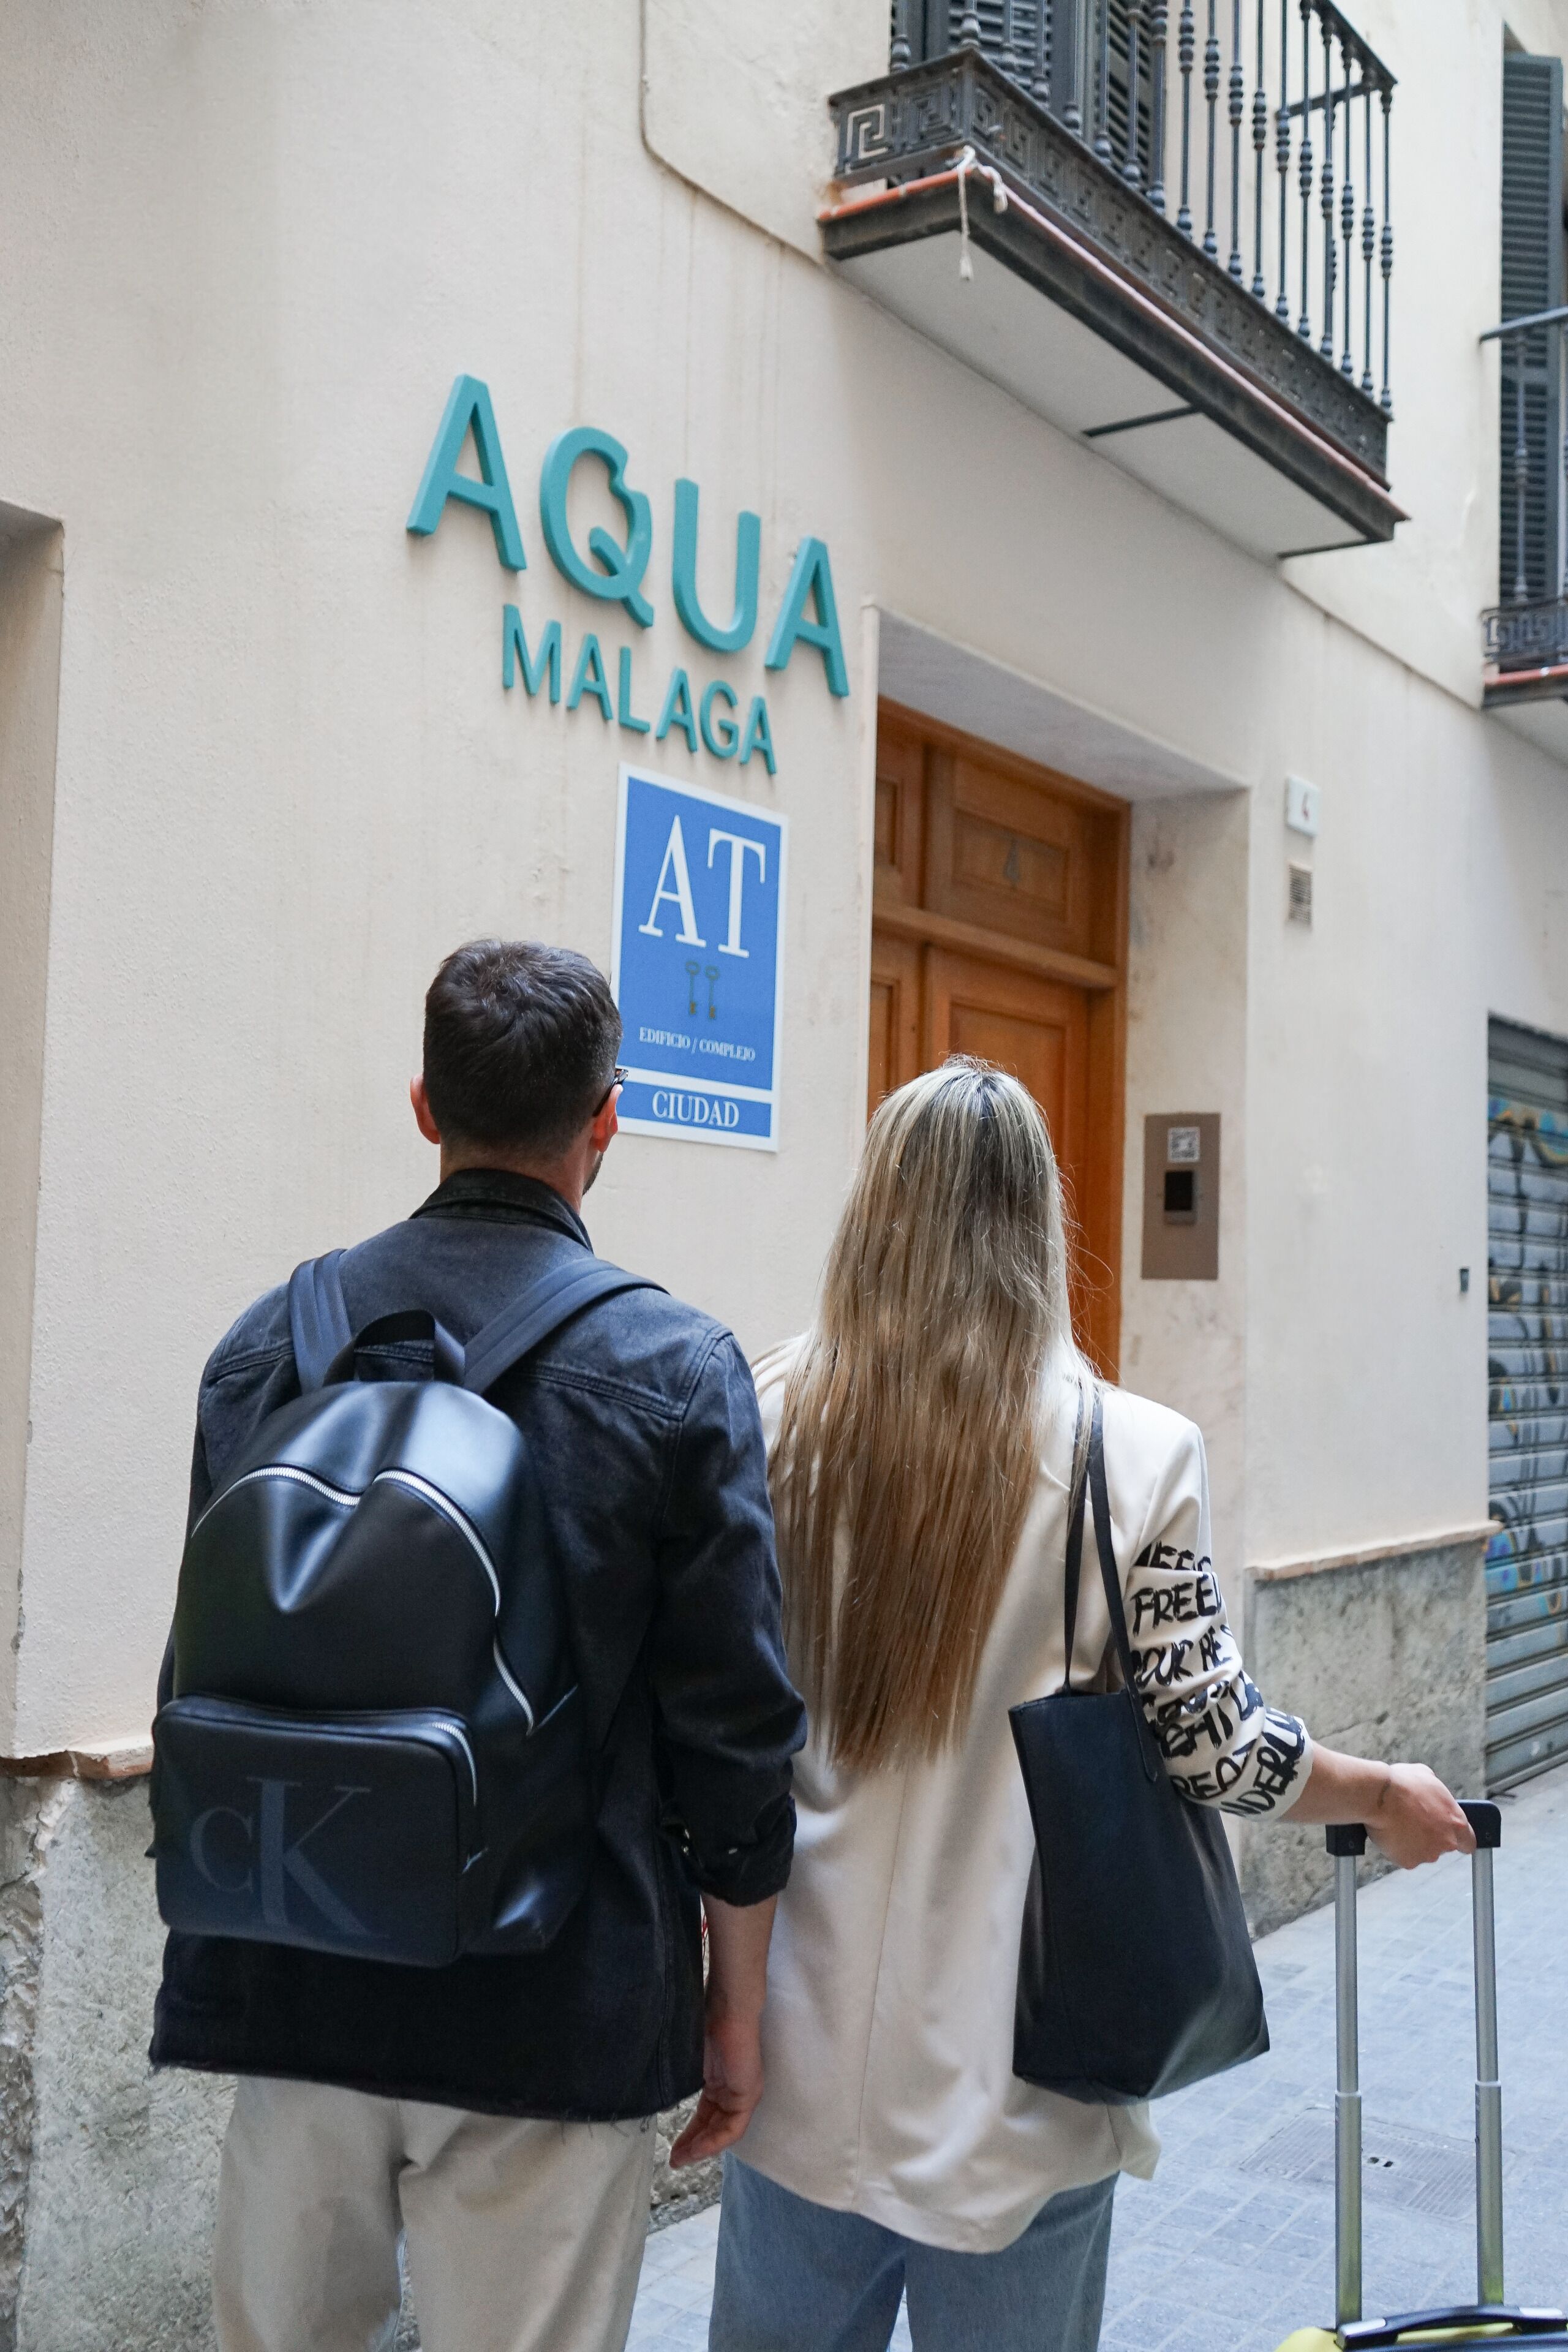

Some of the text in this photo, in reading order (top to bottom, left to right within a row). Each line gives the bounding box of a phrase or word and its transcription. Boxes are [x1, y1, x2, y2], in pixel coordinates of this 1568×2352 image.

[407, 374, 850, 698] AQUA
[503, 603, 777, 775] MALAGA
[638, 815, 766, 959] AT
[639, 1026, 691, 1050] EDIFICIO
[698, 1039, 756, 1061] COMPLEJO
[652, 1090, 740, 1128] CIUDAD
